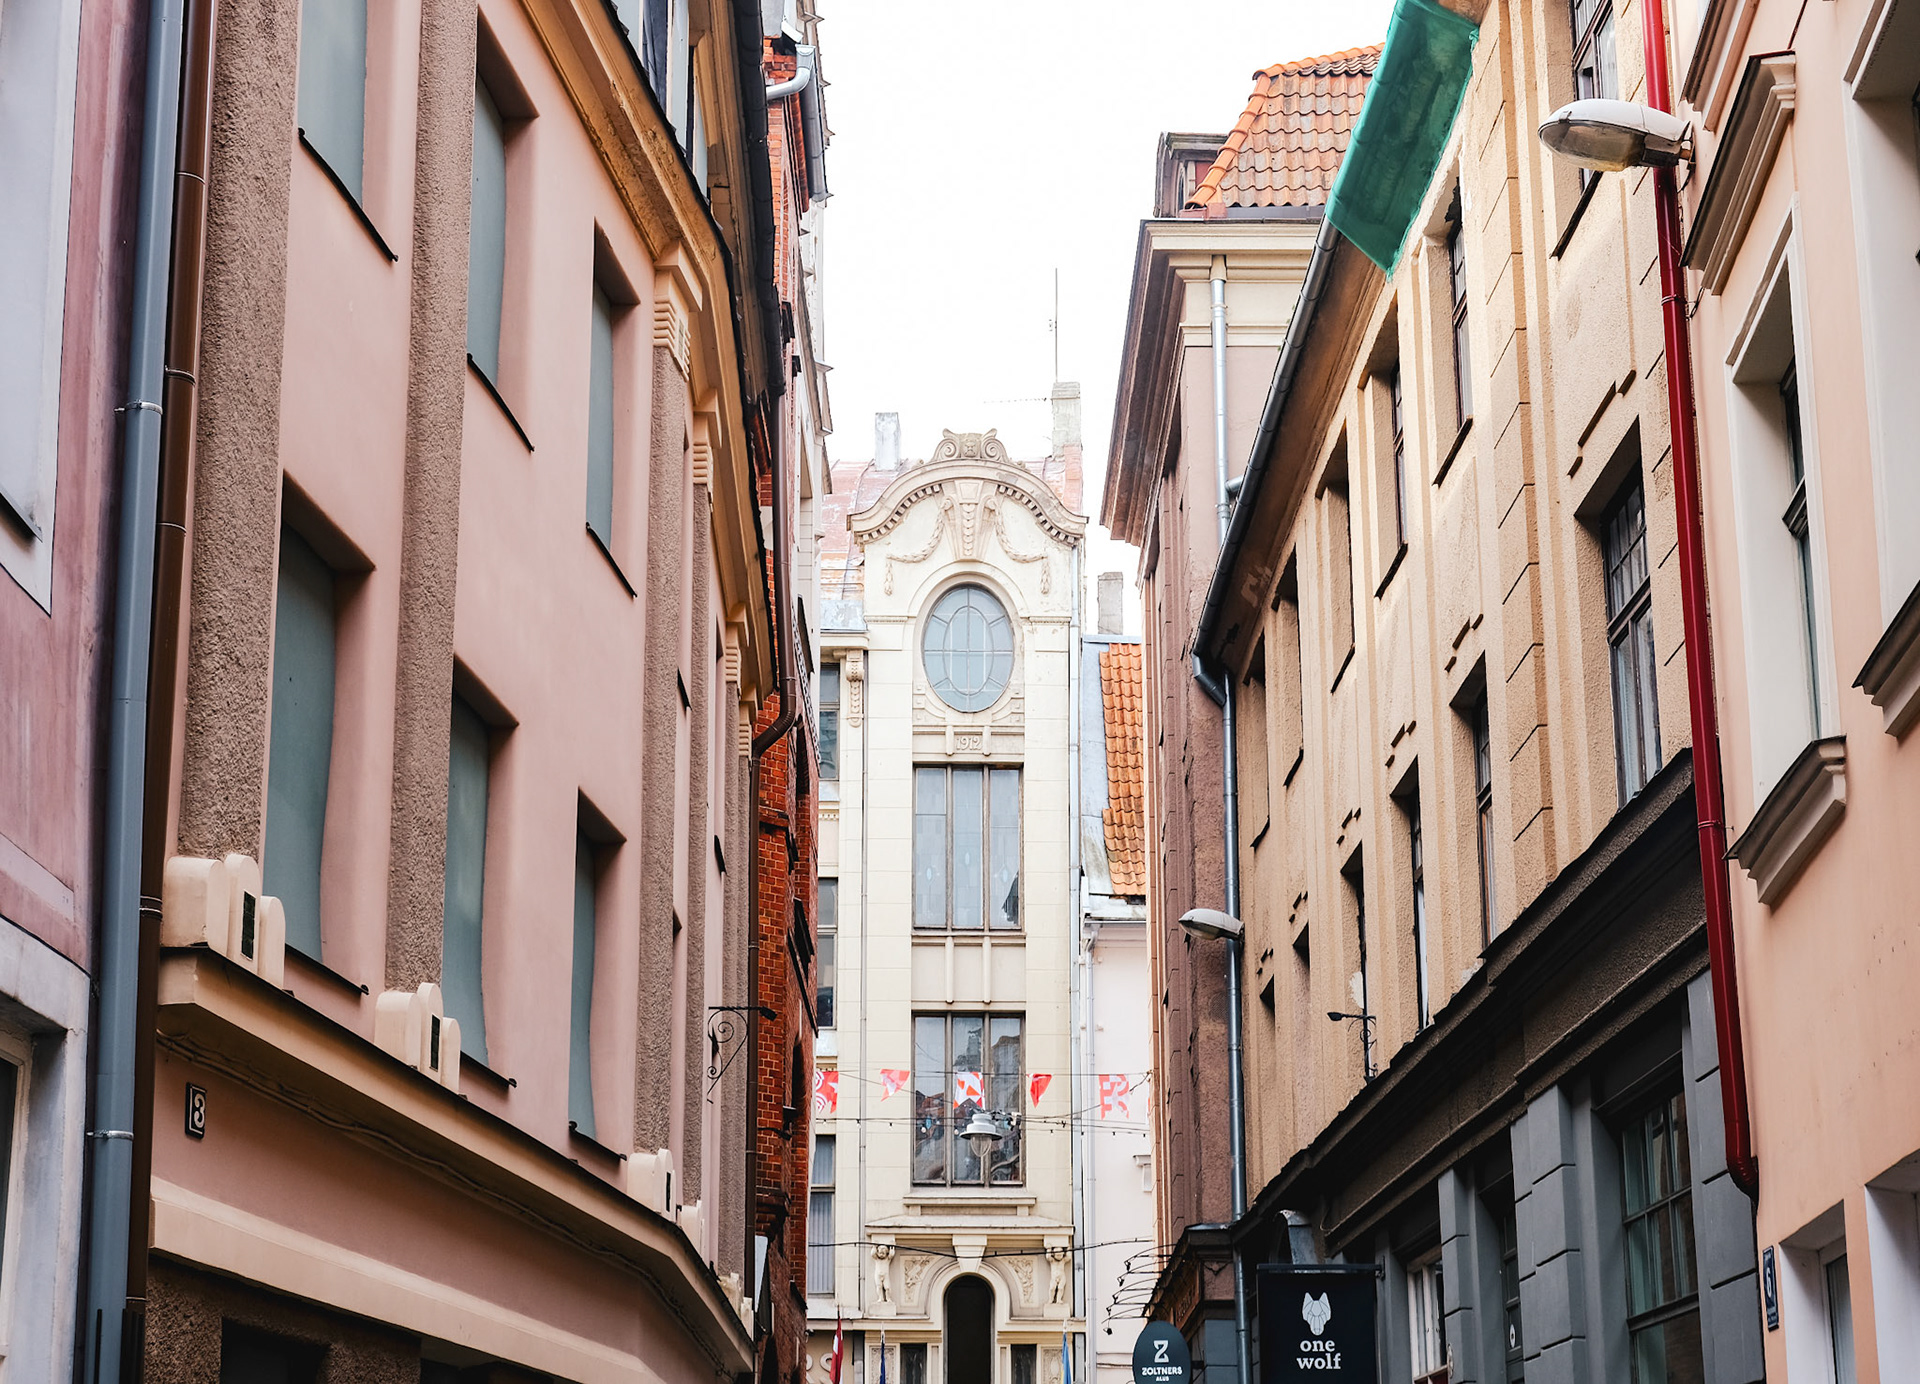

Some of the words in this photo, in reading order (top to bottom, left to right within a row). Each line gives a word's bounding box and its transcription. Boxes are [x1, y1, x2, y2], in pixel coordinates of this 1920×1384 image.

[956, 736, 982, 750] 1912
[194, 1093, 205, 1128] 3
[1766, 1267, 1772, 1298] 6
[1153, 1340, 1170, 1363] Z
[1300, 1340, 1335, 1352] one
[1296, 1353, 1341, 1370] wolf
[1142, 1366, 1183, 1375] ZOLTNERS
